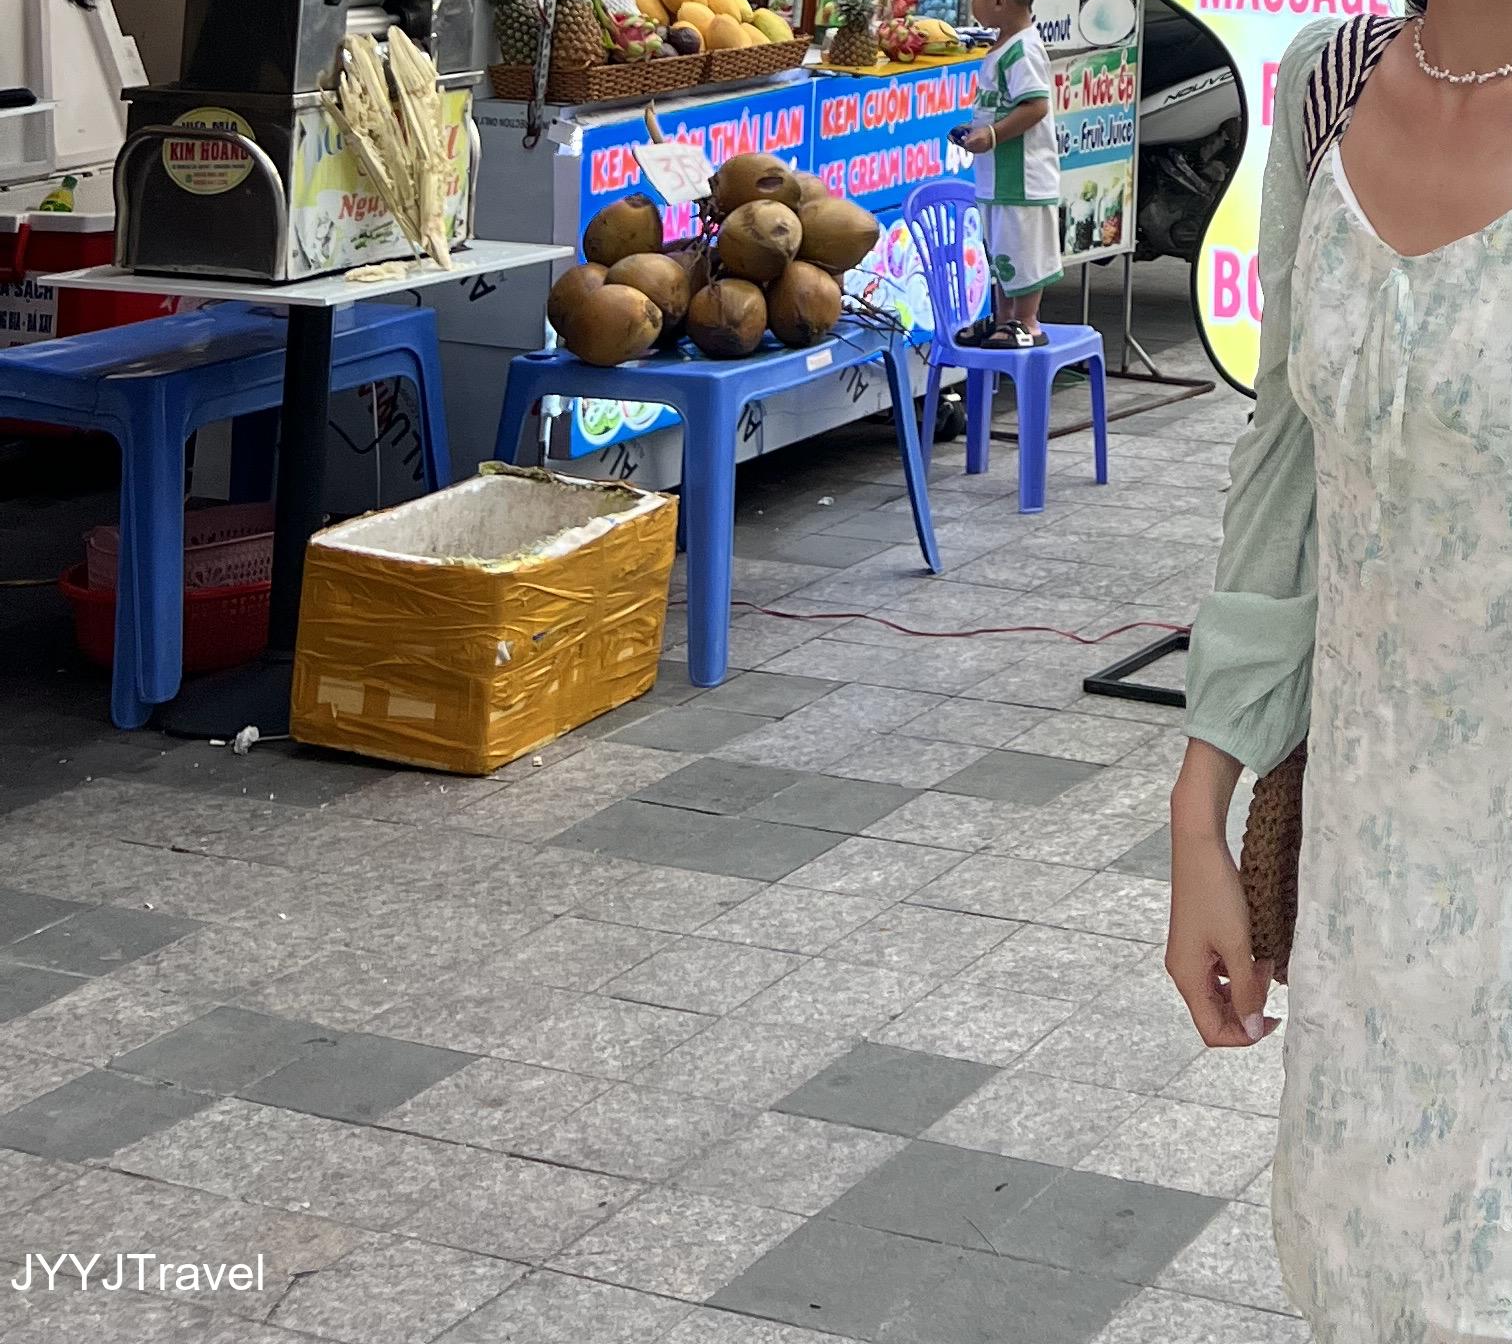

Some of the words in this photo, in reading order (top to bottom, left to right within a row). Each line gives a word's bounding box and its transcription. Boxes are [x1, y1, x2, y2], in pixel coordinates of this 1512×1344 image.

[820, 93, 860, 140] KEM
[863, 78, 913, 134] CUỘN
[915, 65, 957, 119] THÁI
[958, 70, 979, 109] LA
[170, 142, 196, 161] KIM
[709, 106, 761, 165] THÁI
[763, 105, 805, 153] LAN
[849, 145, 901, 196] CREAM
[904, 136, 943, 181] ROLL
